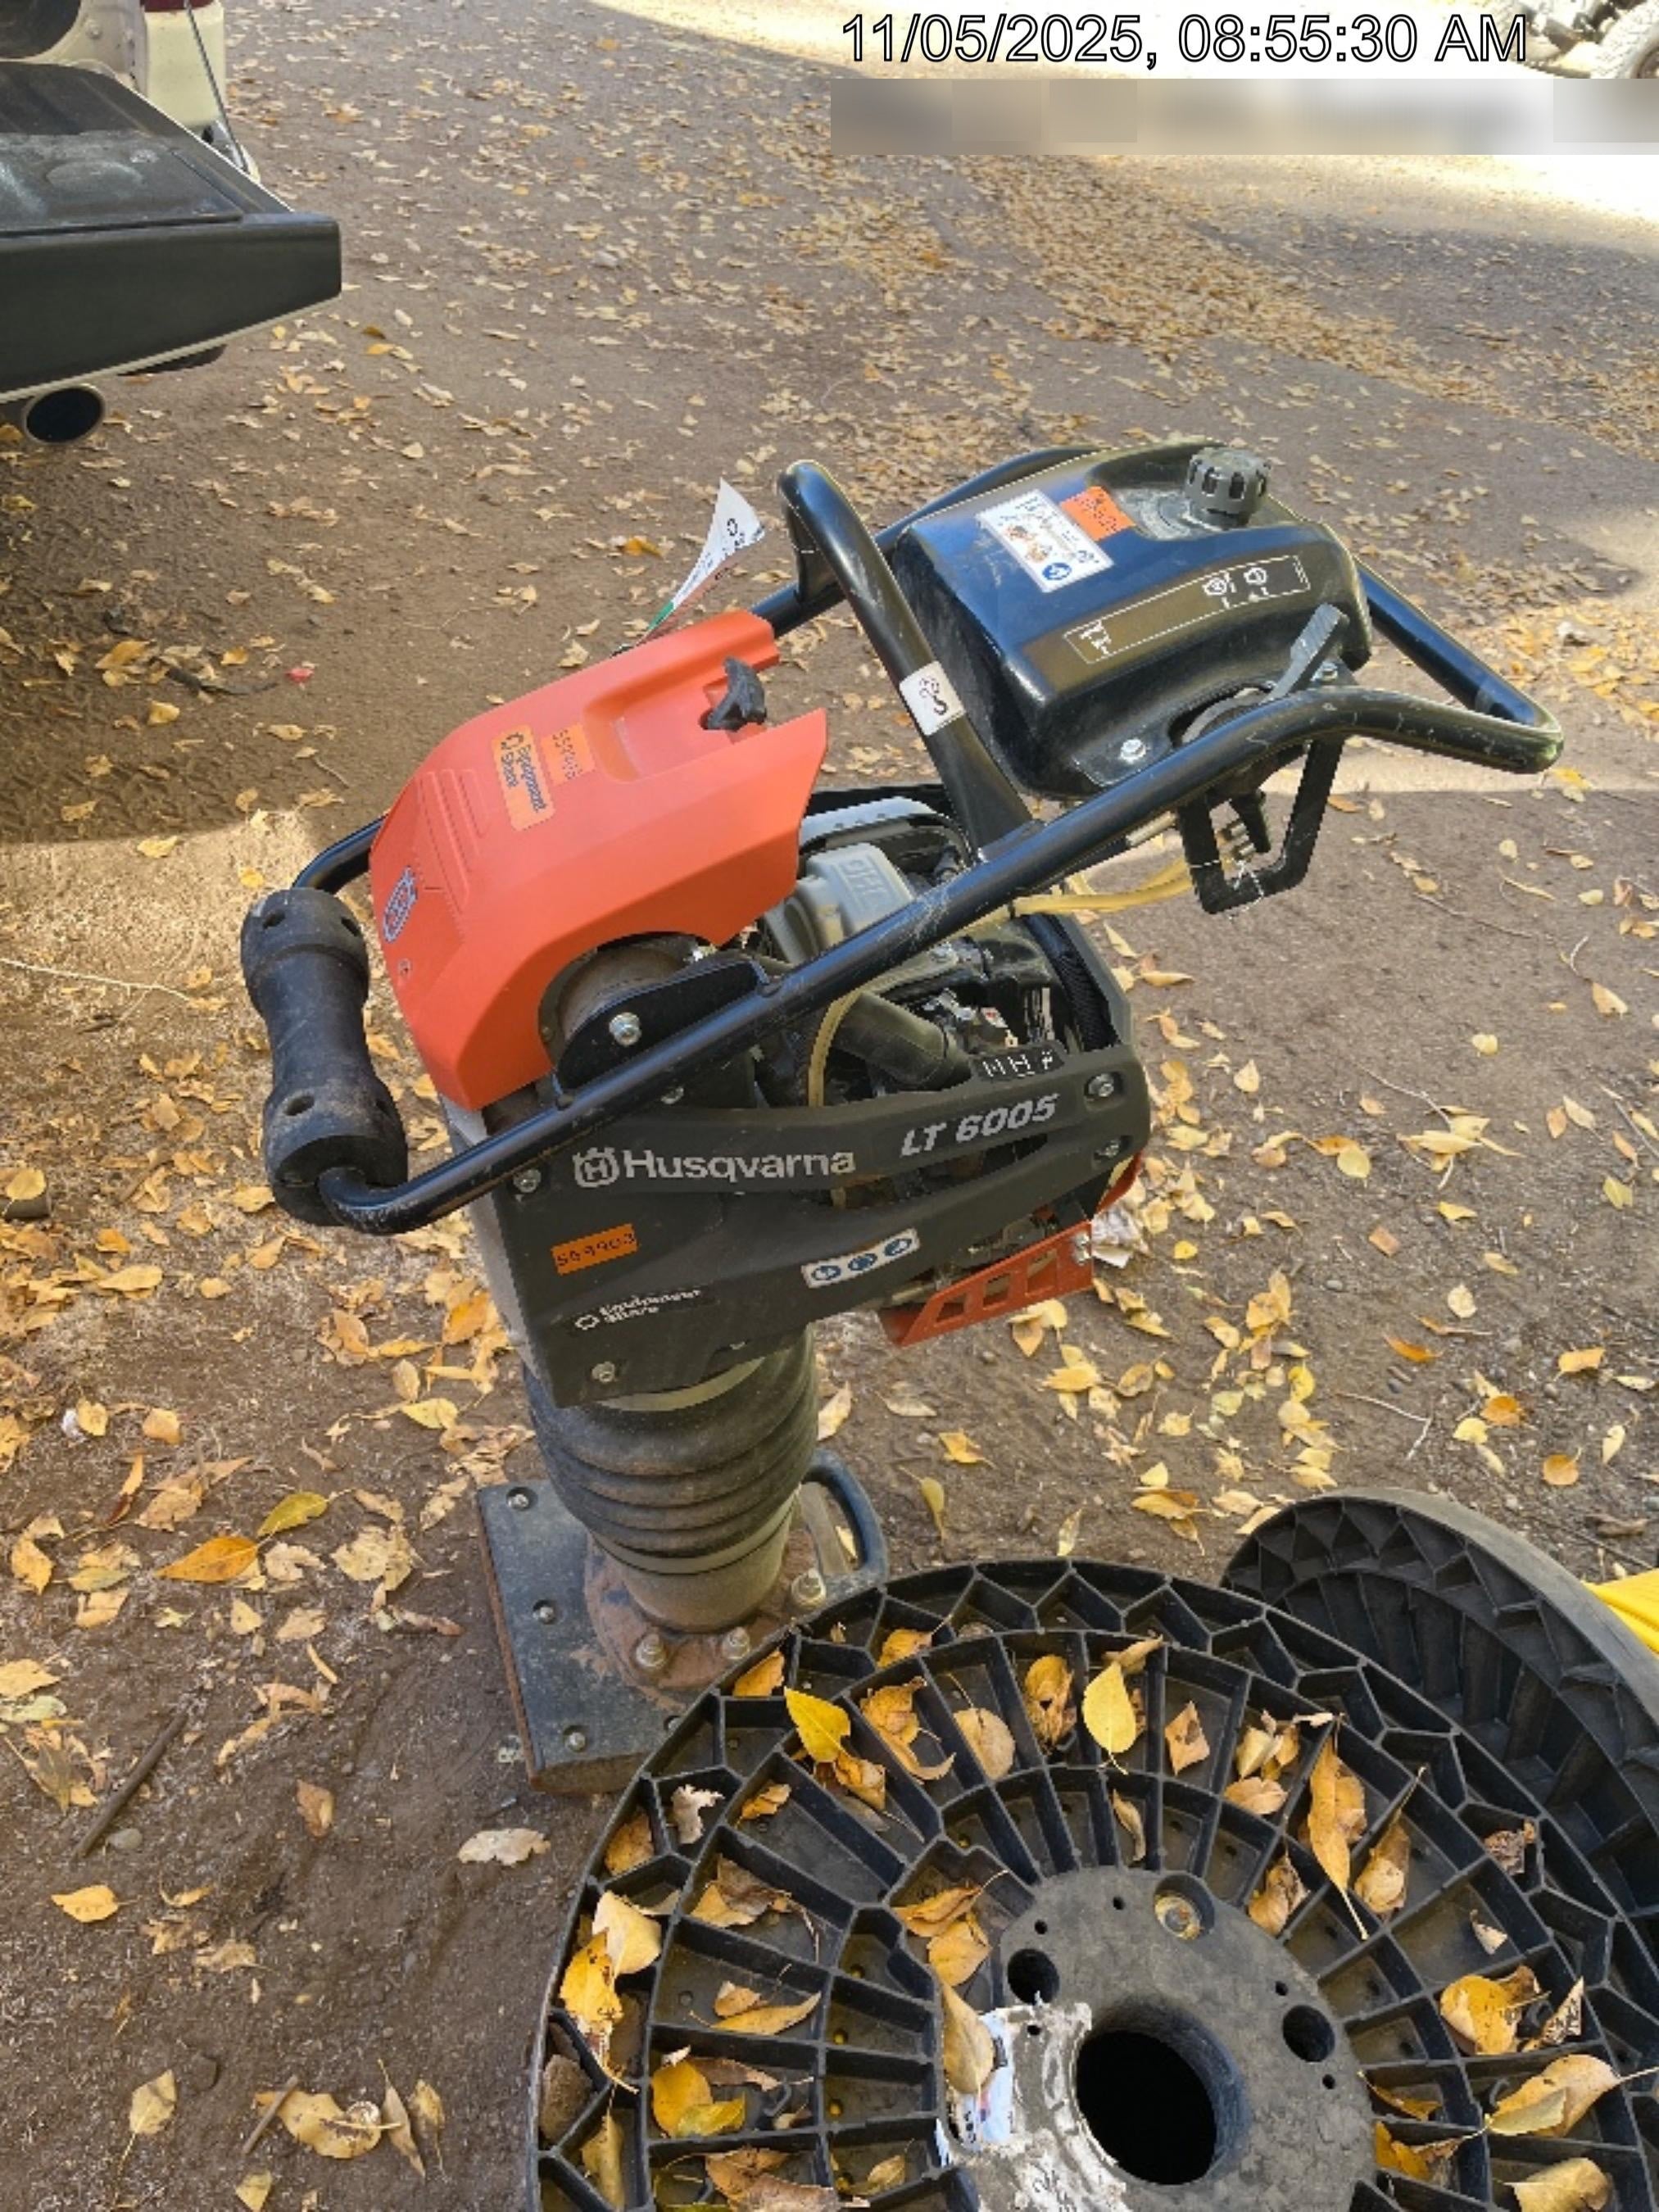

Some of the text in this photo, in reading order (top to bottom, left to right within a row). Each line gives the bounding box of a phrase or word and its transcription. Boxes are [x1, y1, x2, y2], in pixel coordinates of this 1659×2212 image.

[900, 1092, 1061, 1157] LT 6005
[622, 1149, 857, 1183] Husqvarna
